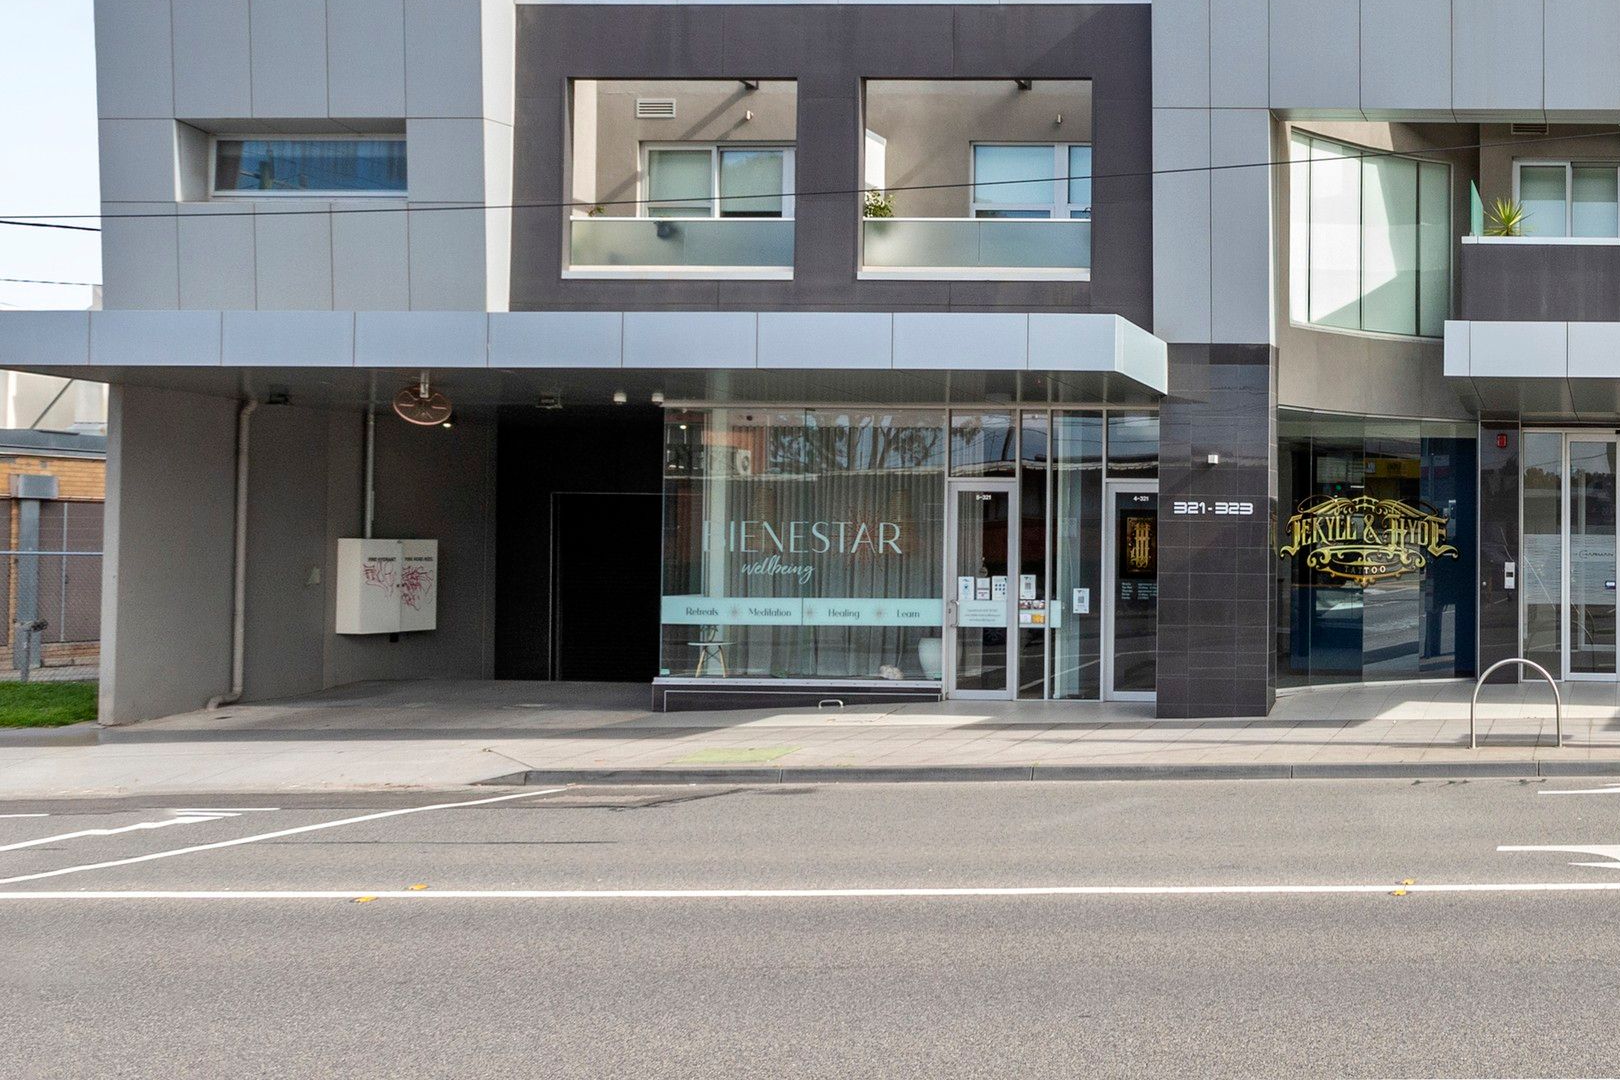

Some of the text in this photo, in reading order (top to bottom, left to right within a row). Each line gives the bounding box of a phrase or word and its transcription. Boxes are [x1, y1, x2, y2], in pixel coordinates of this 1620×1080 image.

[702, 520, 902, 554] BIENESTAR
[1280, 513, 1459, 560] JEKYLL & HYDE
[741, 555, 815, 584] wellbeing
[1343, 565, 1387, 574] TATTOO
[685, 607, 719, 617] Retreats
[748, 607, 792, 617] Meditation
[828, 608, 860, 619] Healing
[896, 609, 920, 618] Learn
